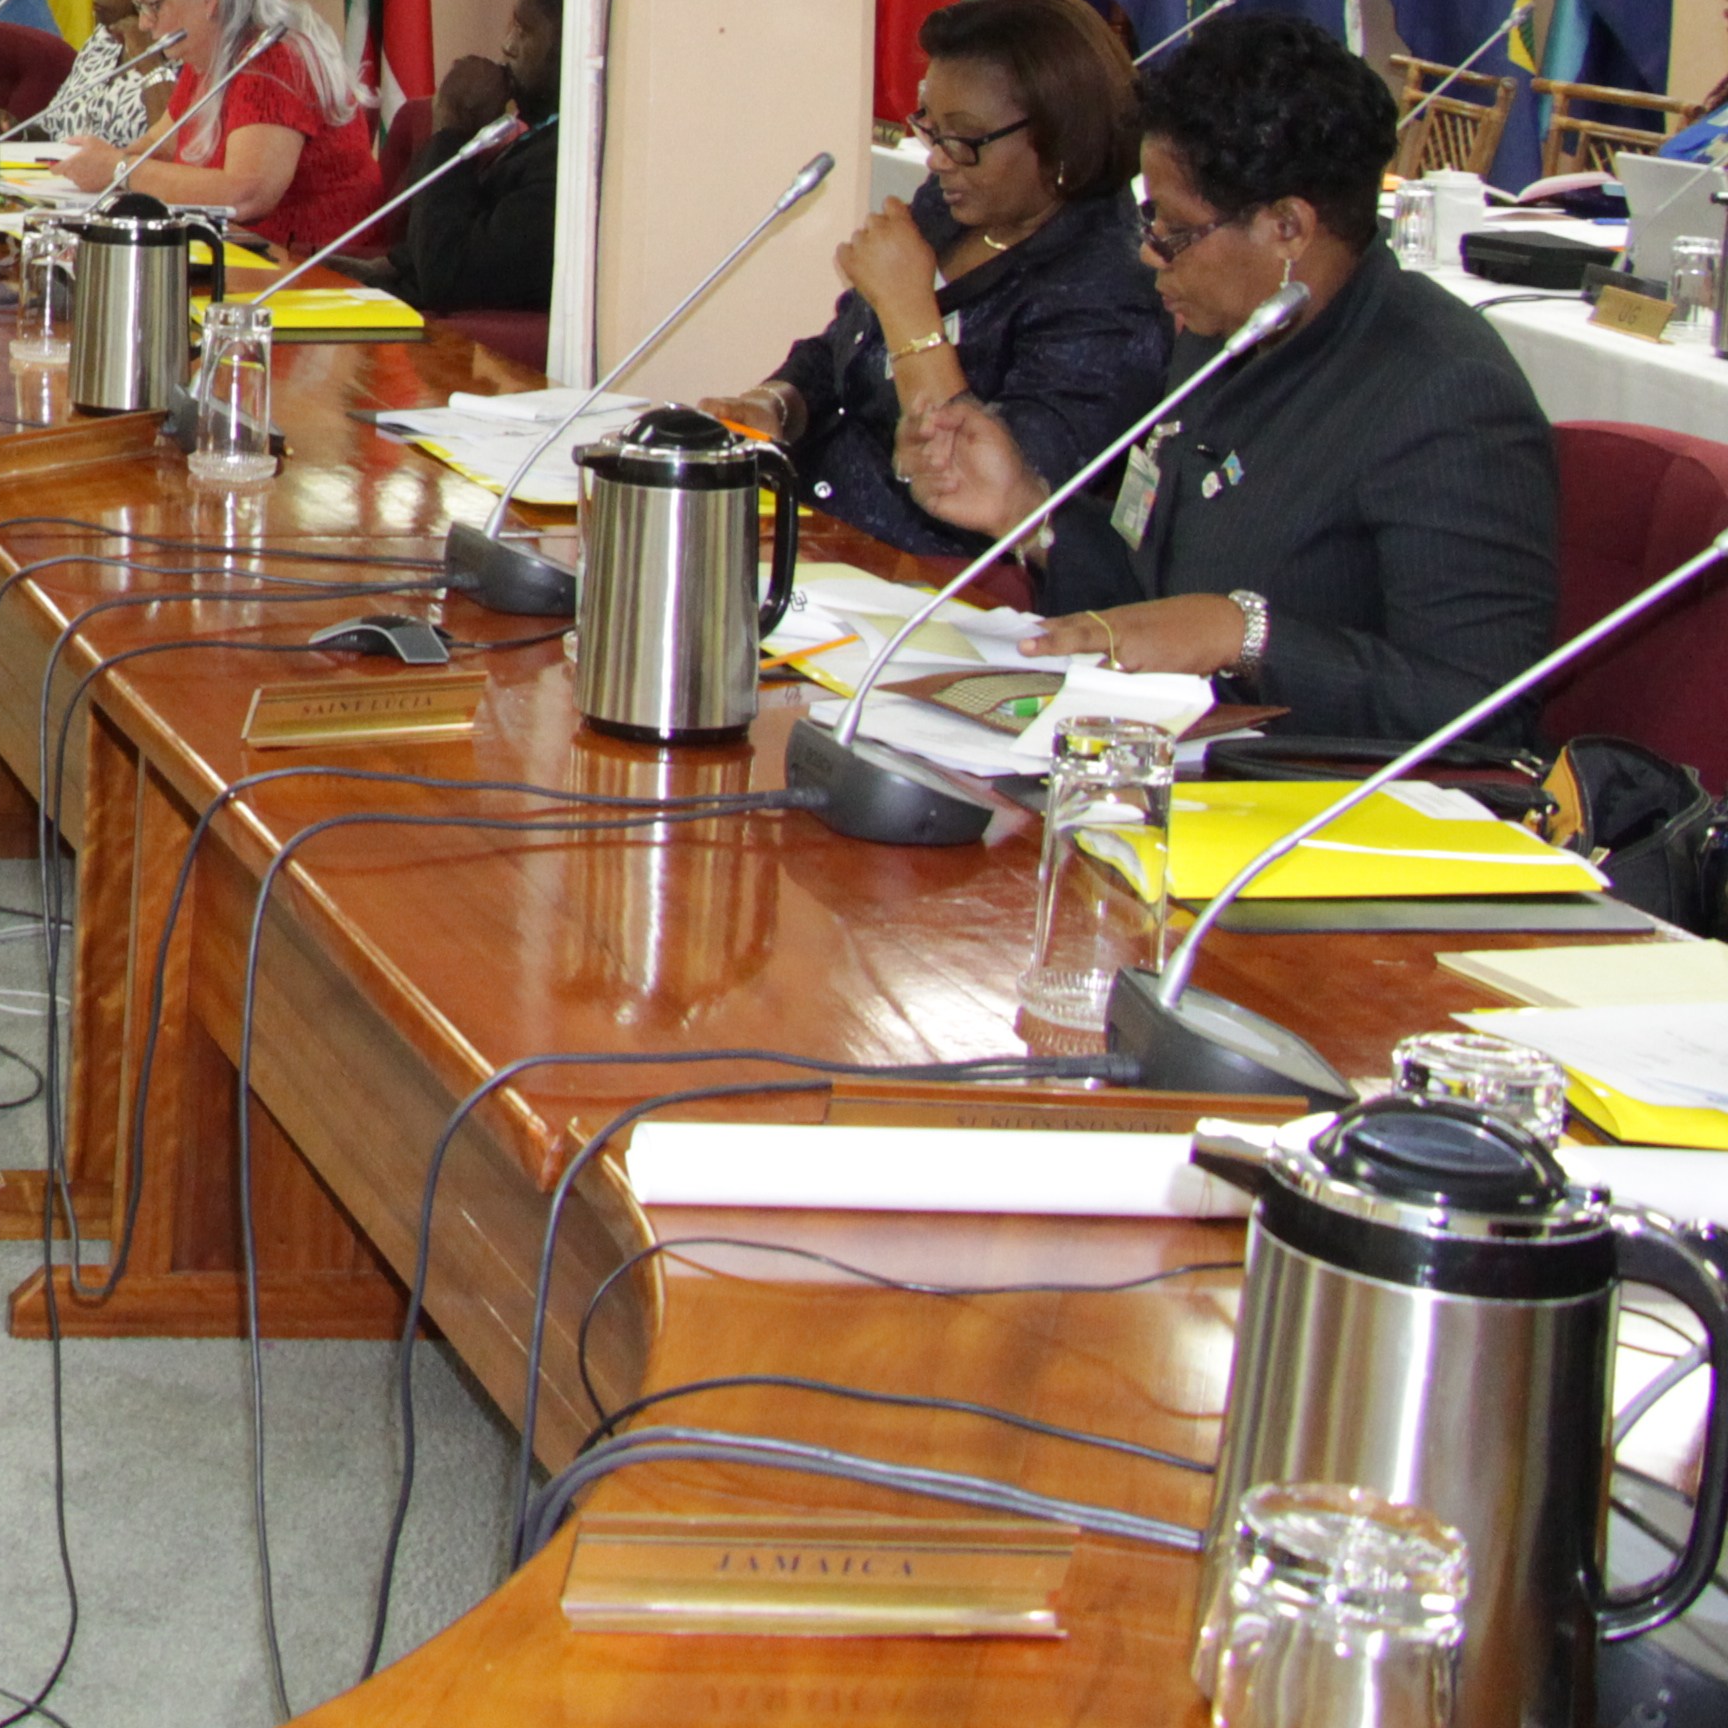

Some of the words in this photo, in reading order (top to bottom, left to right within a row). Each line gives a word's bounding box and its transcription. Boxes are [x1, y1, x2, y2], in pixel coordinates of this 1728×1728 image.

[302, 699, 361, 714] SAINT
[370, 696, 433, 711] LUCIA
[715, 1552, 914, 1576] JAMAICA
